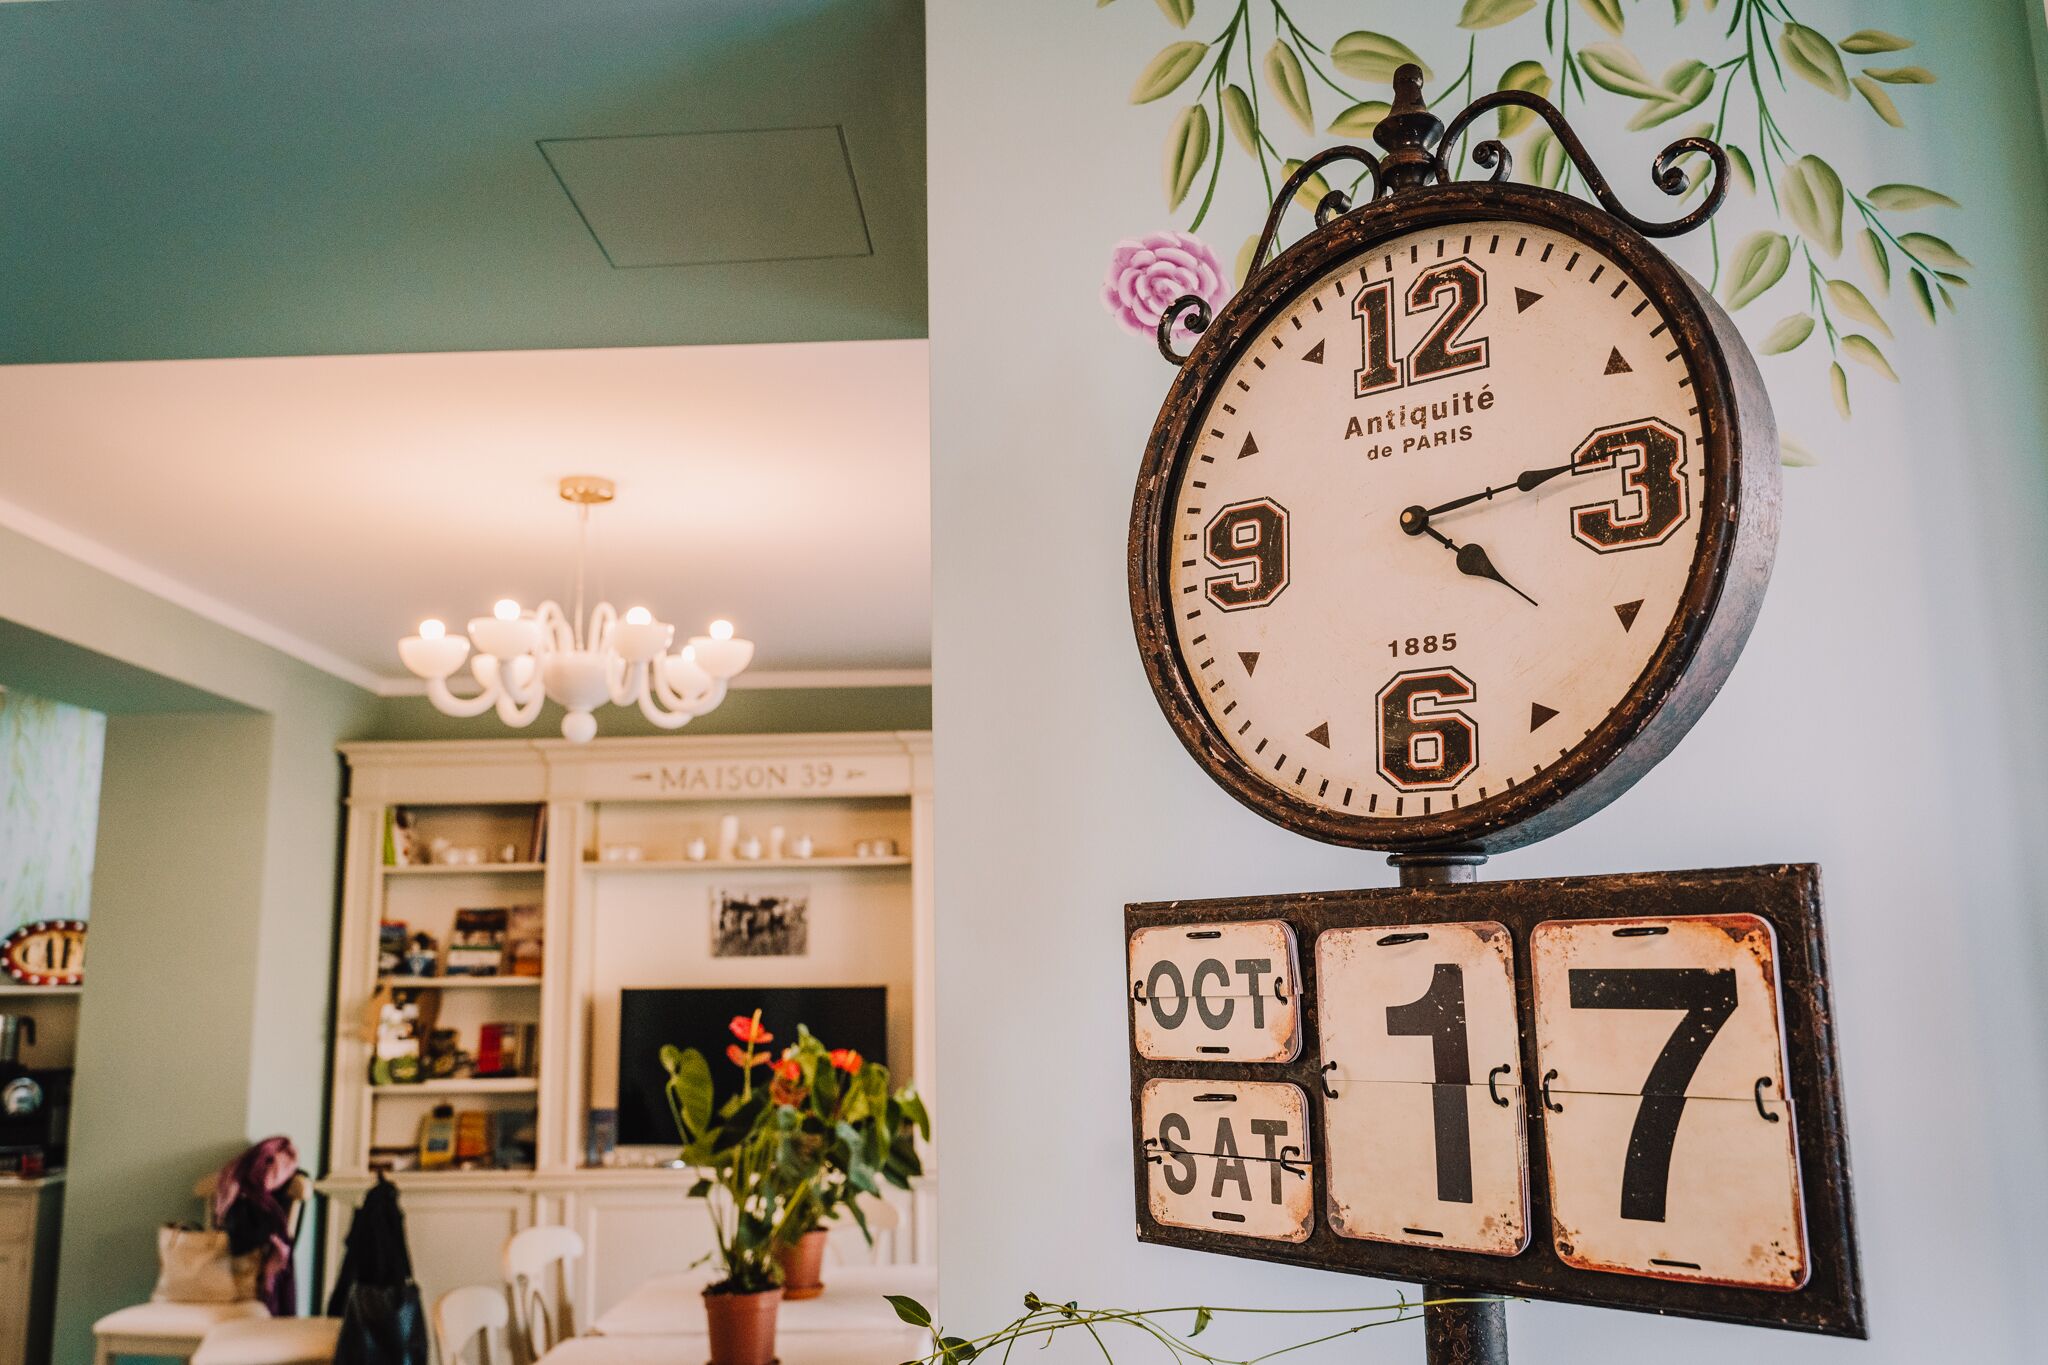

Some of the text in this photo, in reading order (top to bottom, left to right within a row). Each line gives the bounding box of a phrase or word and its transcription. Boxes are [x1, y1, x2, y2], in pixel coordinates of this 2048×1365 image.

[1352, 257, 1490, 398] 12
[1344, 383, 1495, 440] Antiquité
[1367, 425, 1473, 460] de PARIS
[1570, 416, 1690, 555] 3
[1204, 497, 1291, 613] 9
[1387, 632, 1458, 658] 1885
[1375, 665, 1479, 793] 6
[660, 761, 834, 790] MAISON 39
[1147, 958, 1271, 1031] OCT
[1159, 1112, 1287, 1206] SAT
